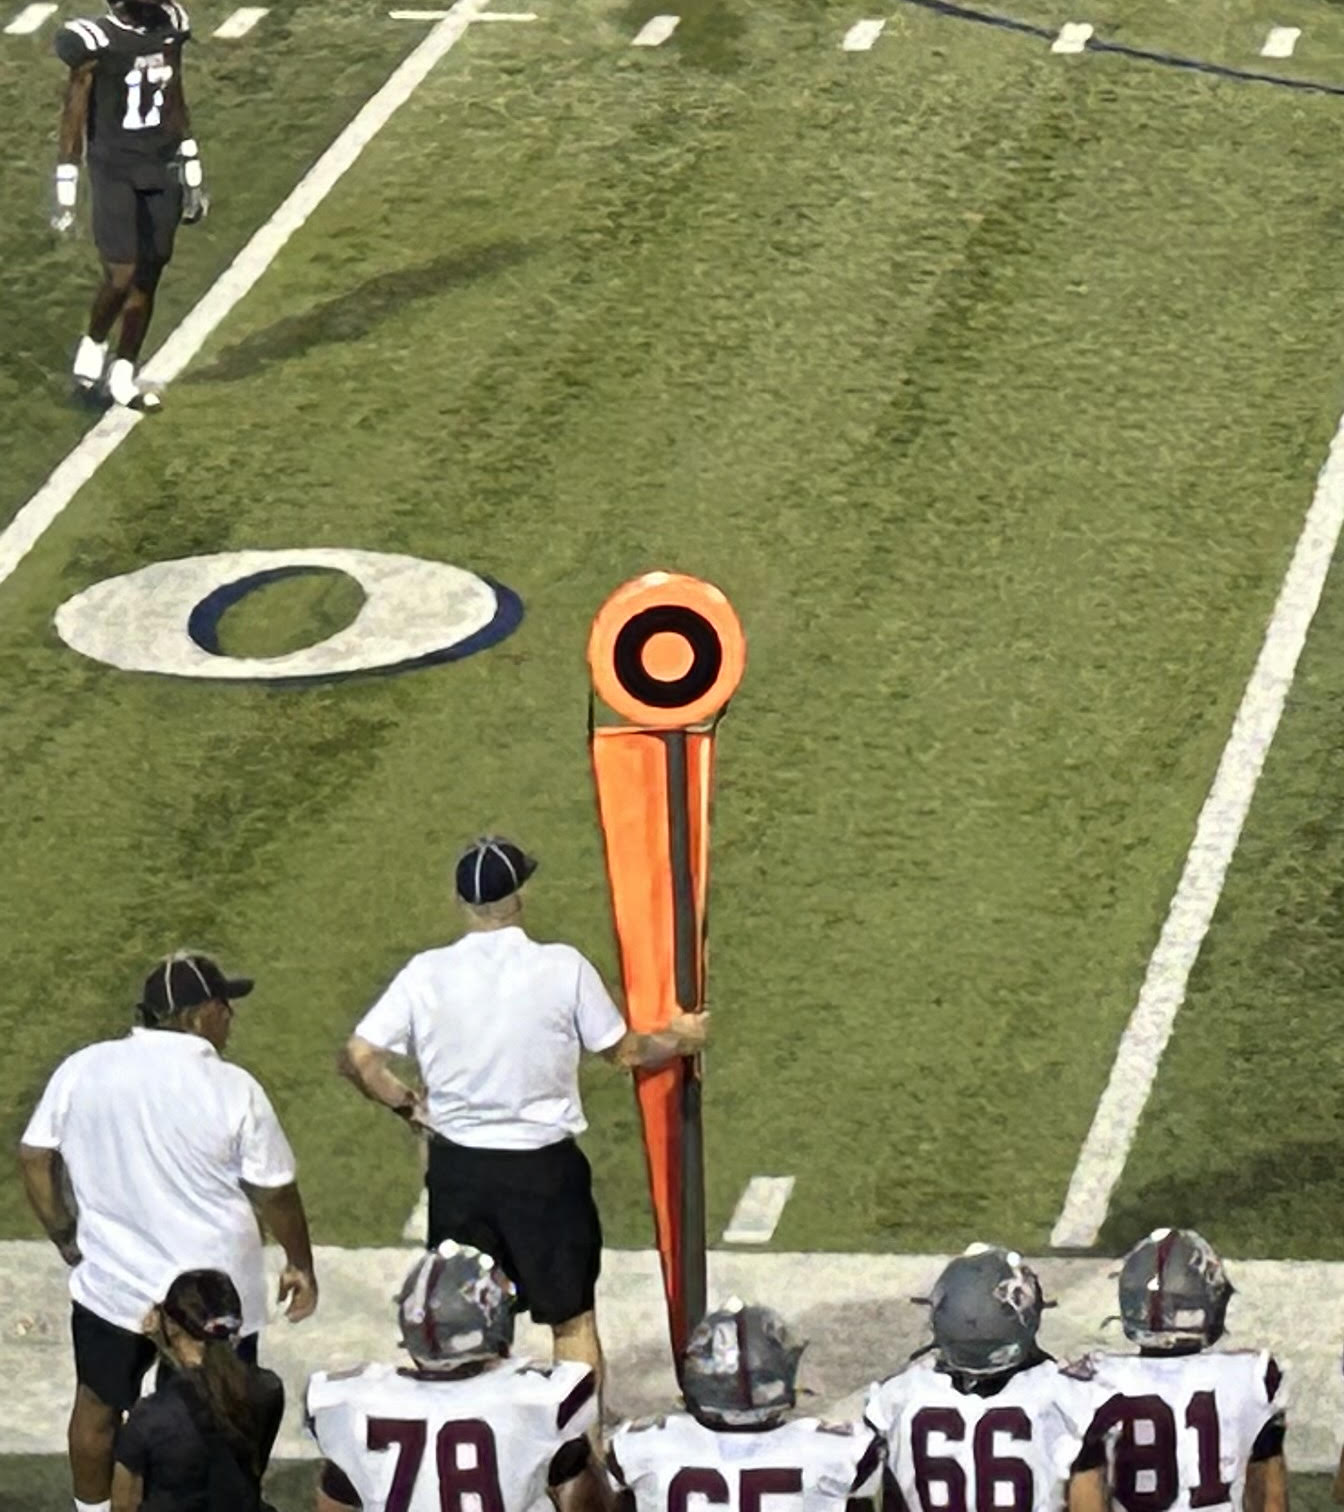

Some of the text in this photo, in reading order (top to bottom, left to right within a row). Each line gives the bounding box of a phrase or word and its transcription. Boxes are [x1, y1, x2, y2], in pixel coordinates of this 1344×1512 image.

[122, 65, 174, 129] 17
[366, 1418, 497, 1512] 78
[910, 1406, 1035, 1512] 66
[1112, 1390, 1233, 1512] 81
